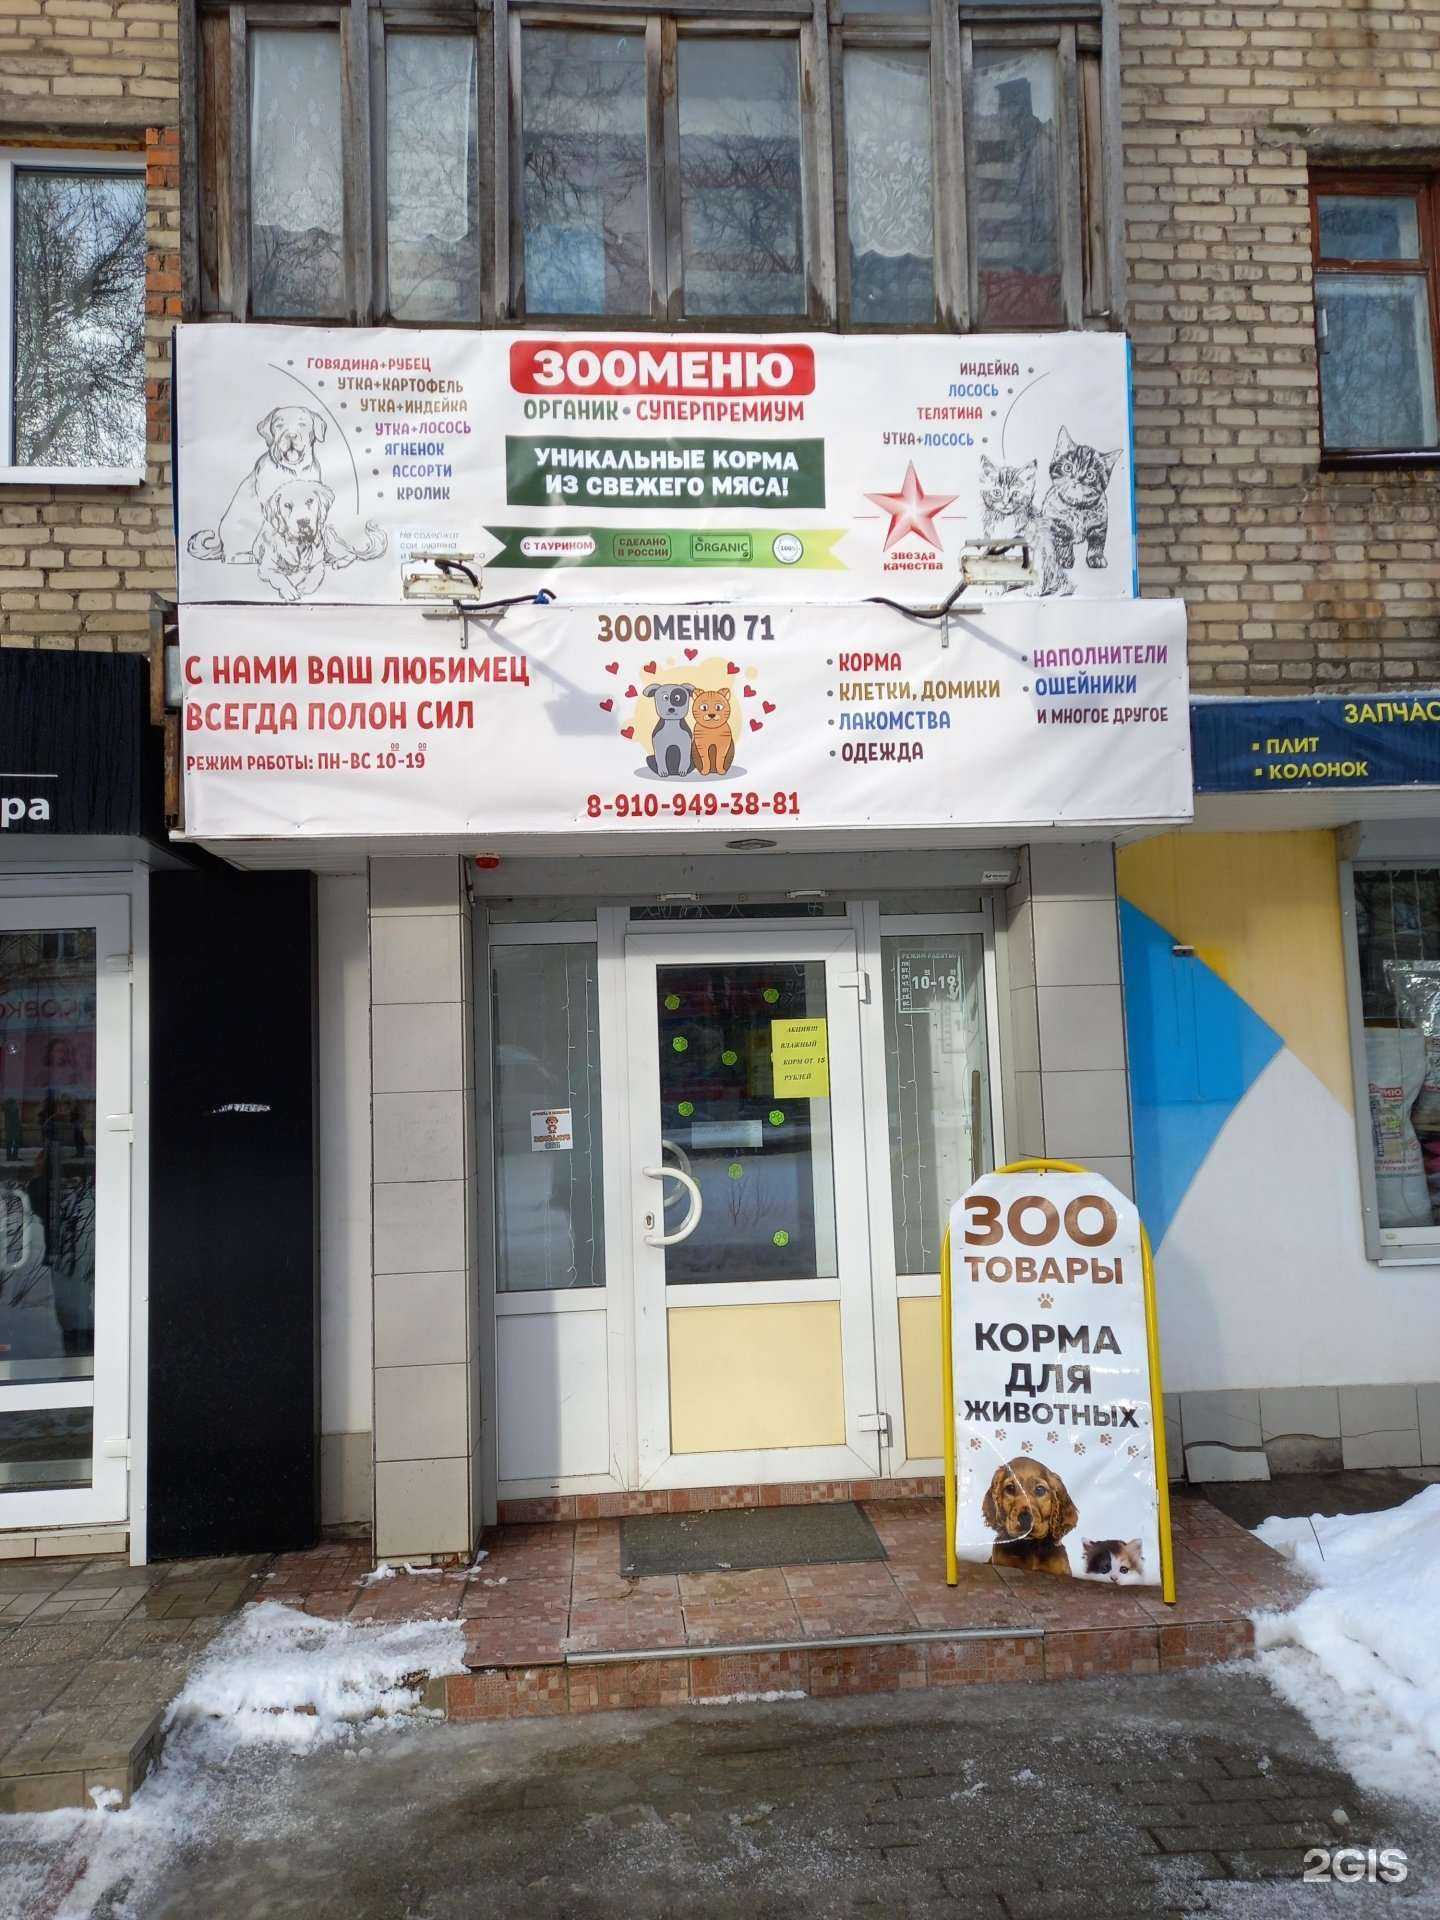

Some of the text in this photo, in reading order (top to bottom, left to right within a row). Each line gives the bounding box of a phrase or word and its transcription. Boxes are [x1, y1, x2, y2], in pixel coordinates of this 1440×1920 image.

[306, 357, 432, 373] ГОВЯДИНА+РУБЕЦ
[532, 350, 794, 388] ЗООМЕНЮ
[959, 359, 1019, 376] ИНДЕЙКА
[337, 377, 464, 394] УТКА+КАРТОФЕЛЬ
[948, 384, 999, 397] ЛОСОСЬ
[360, 396, 469, 414] УТКА+ИНДЕЙКА
[523, 399, 804, 422] ОРГАНИК СУПЕРПРЕМИУМ
[917, 407, 983, 420] ТЕЛЯТИНА
[375, 421, 472, 436] УТКА+ЛОСОСЬ
[882, 432, 974, 446] УТКА+ЛОСОСЬ
[384, 443, 445, 456] ЯГНЕНОК
[535, 448, 800, 471] УНИКАЛЬНЫЕ КОРМА
[392, 464, 453, 478] АССОРТИ
[397, 487, 451, 500] КРОЛИК
[545, 475, 790, 497] ИЗ СВЕЖЕГО МЯСА!
[523, 542, 594, 551] С ТАУРИНОМ
[618, 539, 667, 547] СДЕЛАНО
[694, 542, 749, 553] ORGANIC
[628, 549, 669, 558] РОССИИ
[890, 552, 936, 561] звезда
[883, 562, 943, 571] качества
[597, 614, 775, 642] ЗООМЕНЮ 71
[838, 652, 902, 672] КОРМА
[1033, 645, 1168, 668] НАПОЛНИТЕЛИ
[184, 655, 530, 687] С НАМИ ВАШ ЛЮБИМЕЦ
[839, 679, 1001, 702] КЛЕТКИ, ДОМИКИ
[1035, 671, 1137, 696] ОШЕЙНИКИ
[185, 701, 475, 734] ВСЕГДА ПОЛОН СИЛ
[838, 710, 951, 731] ЛАКОМСТВА
[1037, 707, 1169, 725] И МНОГОЕ ДРУГОЕ
[841, 742, 924, 764] ОДЕЖДА
[1266, 736, 1320, 754] ПЛИТ
[186, 754, 243, 771] РЕЖИМ
[247, 755, 314, 770] РАБОТЫ:
[317, 753, 371, 770] ПН-ВС
[1269, 761, 1369, 779] КОЛОНОК
[587, 791, 801, 818] 8-910-949-38-81
[964, 1195, 1118, 1247] ЗОО
[964, 1256, 1123, 1284] ТОВАРЫ
[974, 1322, 1122, 1355] КОРМА
[1005, 1363, 1092, 1398] ДЛЯ
[964, 1400, 1140, 1428] ЖИВОТНЫХ
